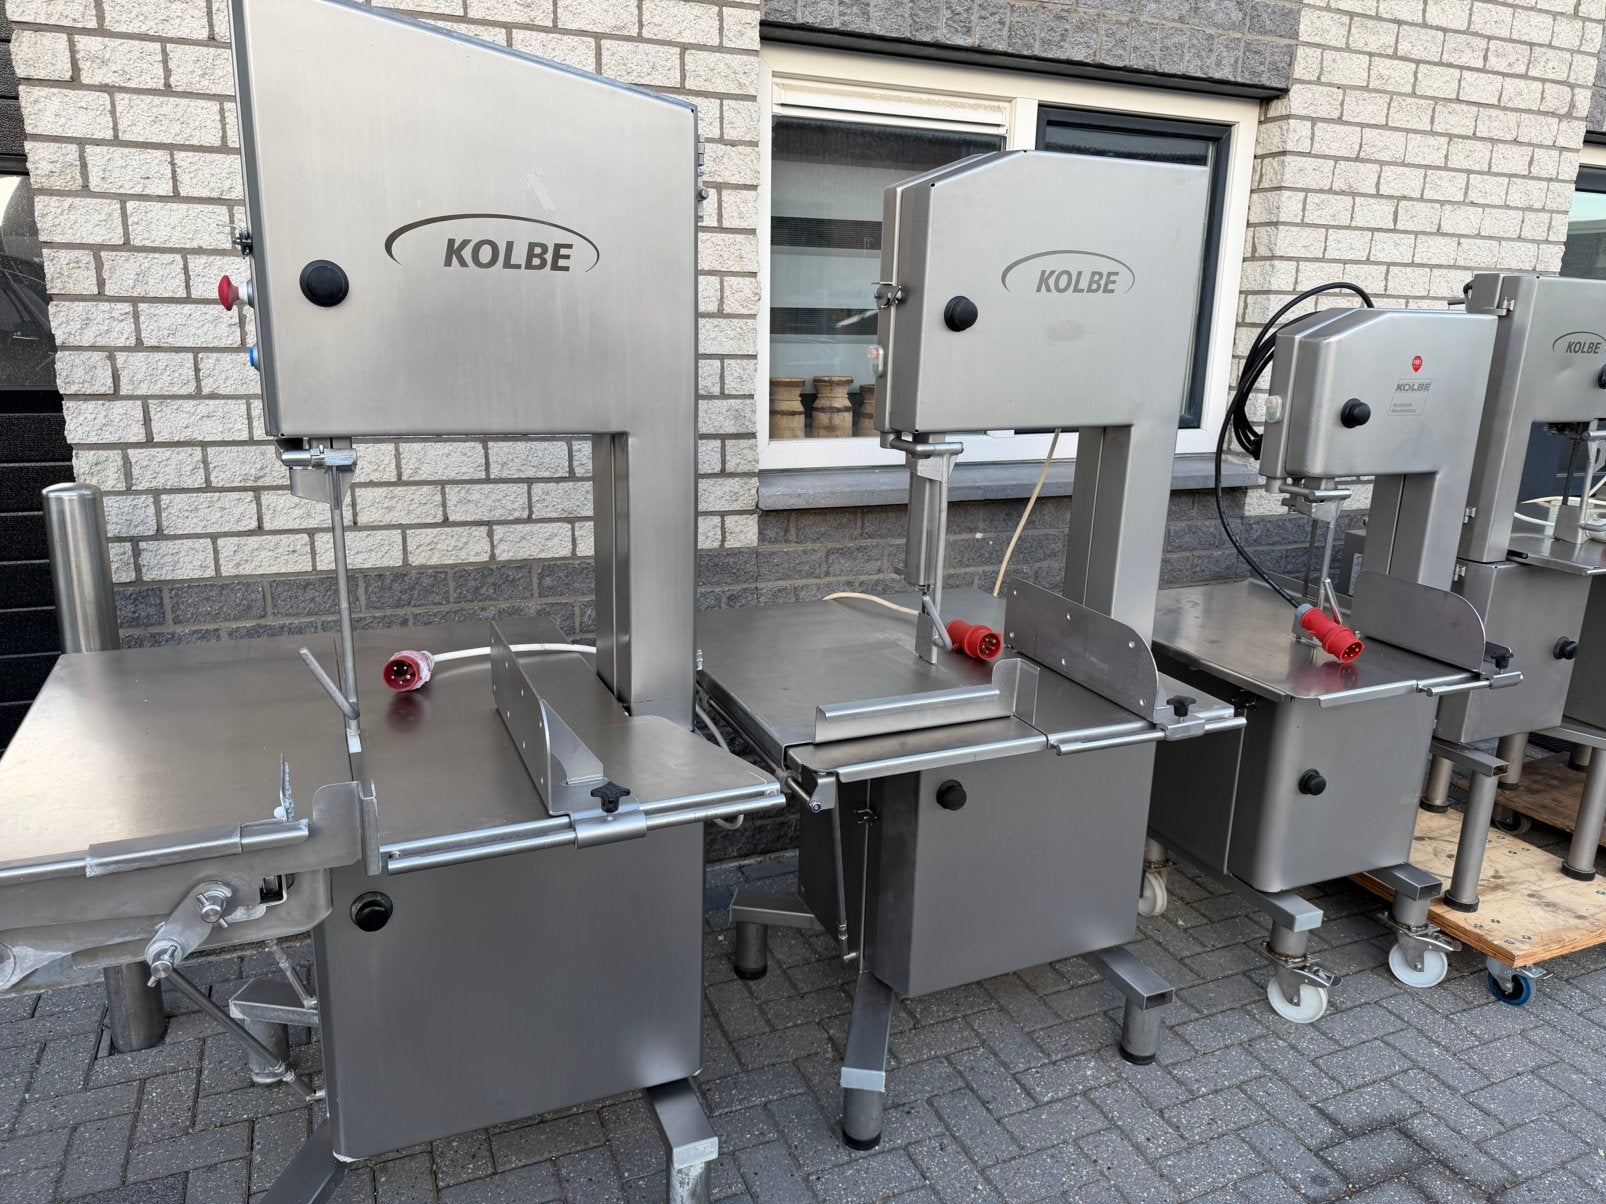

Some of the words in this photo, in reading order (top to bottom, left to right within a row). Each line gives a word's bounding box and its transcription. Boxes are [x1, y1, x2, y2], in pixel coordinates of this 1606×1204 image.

[443, 238, 574, 272] KOLBE
[1036, 269, 1119, 293] KOLBE
[1565, 341, 1602, 354] KOLBE
[1395, 383, 1432, 392] KOLBE
